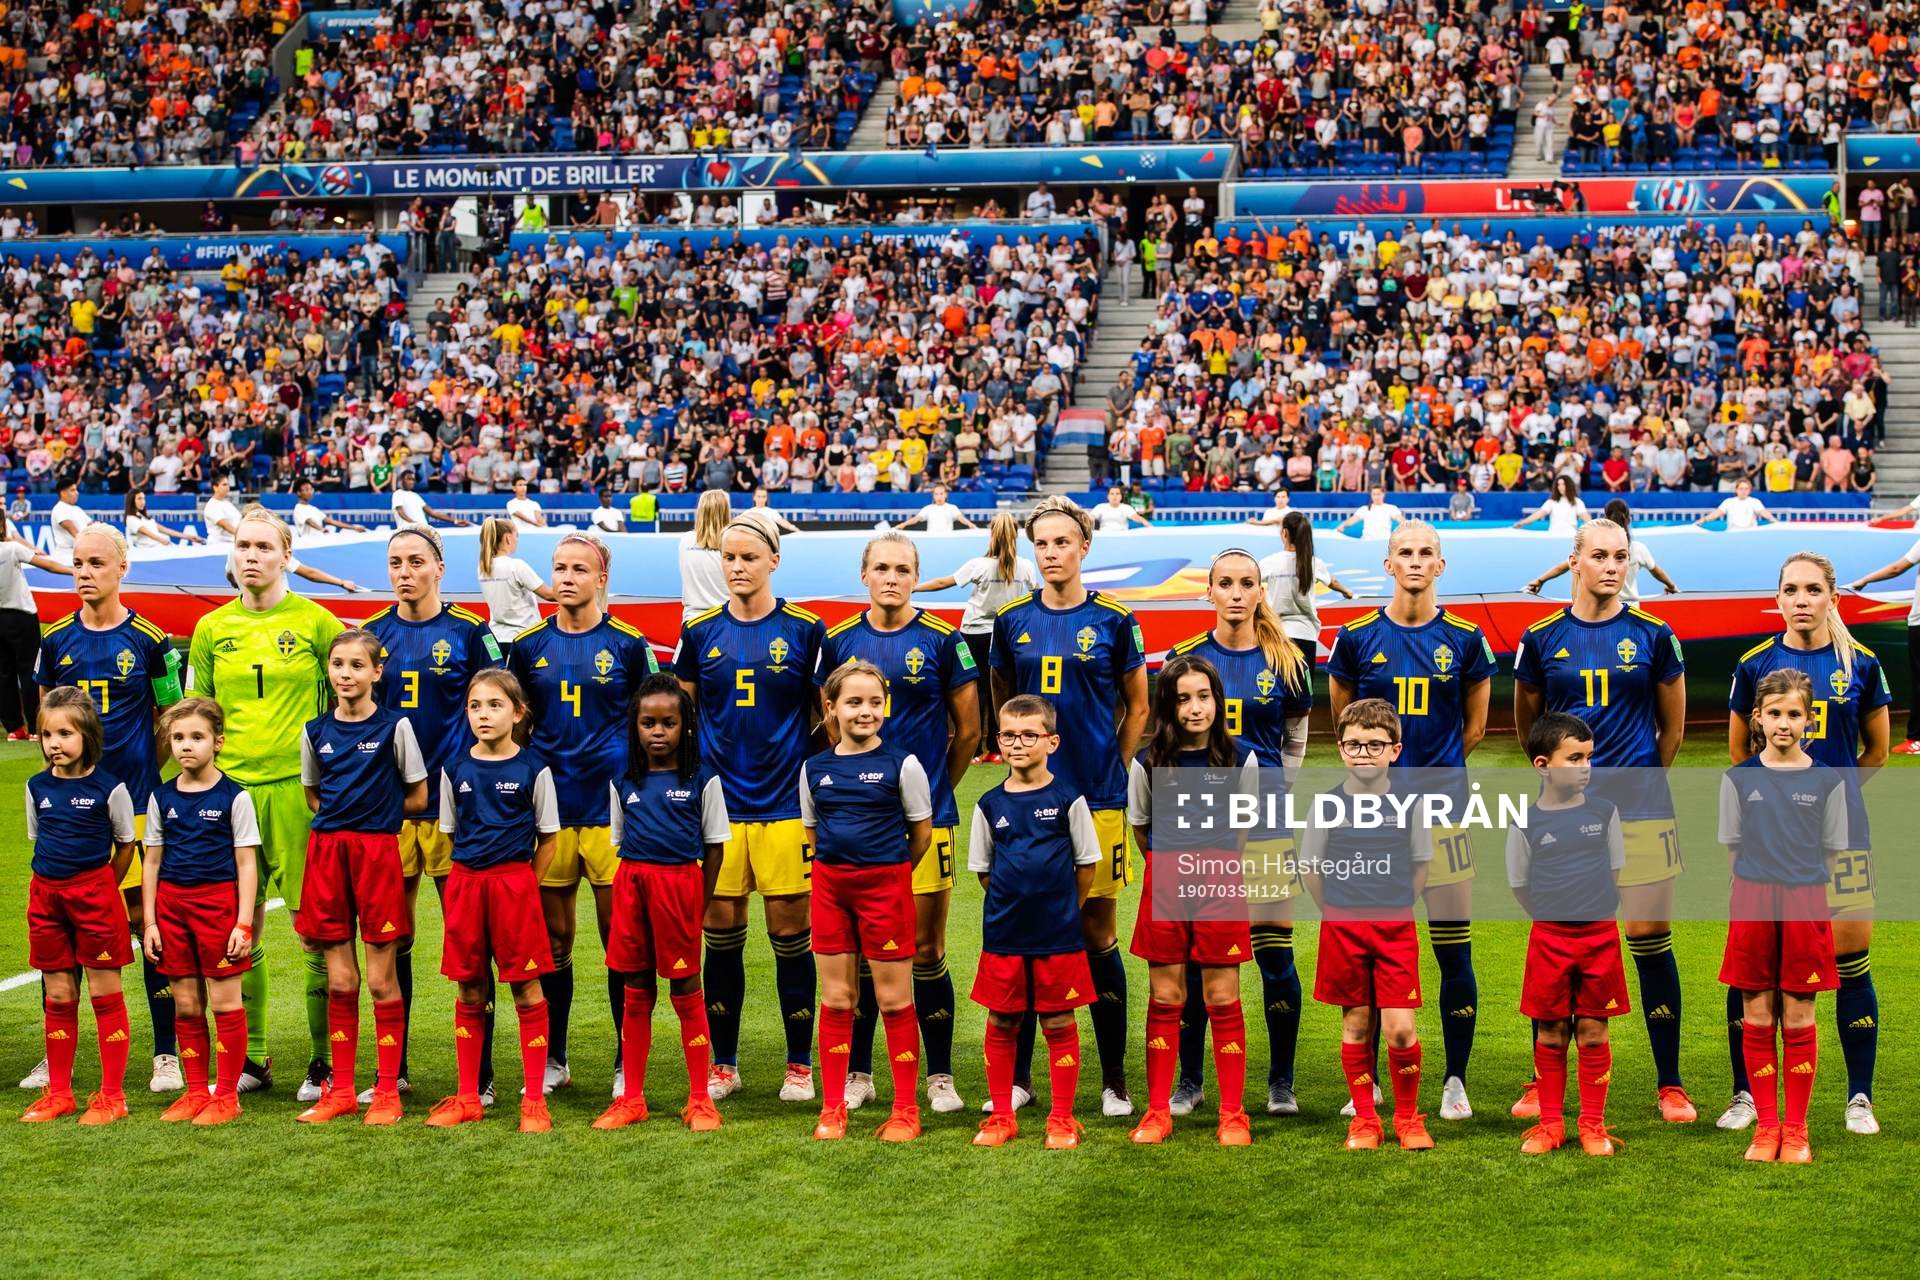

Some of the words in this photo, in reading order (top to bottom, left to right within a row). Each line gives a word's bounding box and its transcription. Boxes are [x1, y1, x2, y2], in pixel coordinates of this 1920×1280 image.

[393, 169, 419, 188] LE
[425, 166, 525, 188] MOMENT
[531, 166, 561, 186] DE
[251, 664, 264, 699] 1
[400, 671, 419, 708] 3
[736, 669, 755, 706] 5
[1041, 656, 1062, 694] 8
[1580, 669, 1608, 706] 11
[561, 680, 581, 717] 4
[1393, 677, 1429, 715] 10
[1438, 833, 1471, 873] 10
[1834, 854, 1870, 894] 23
